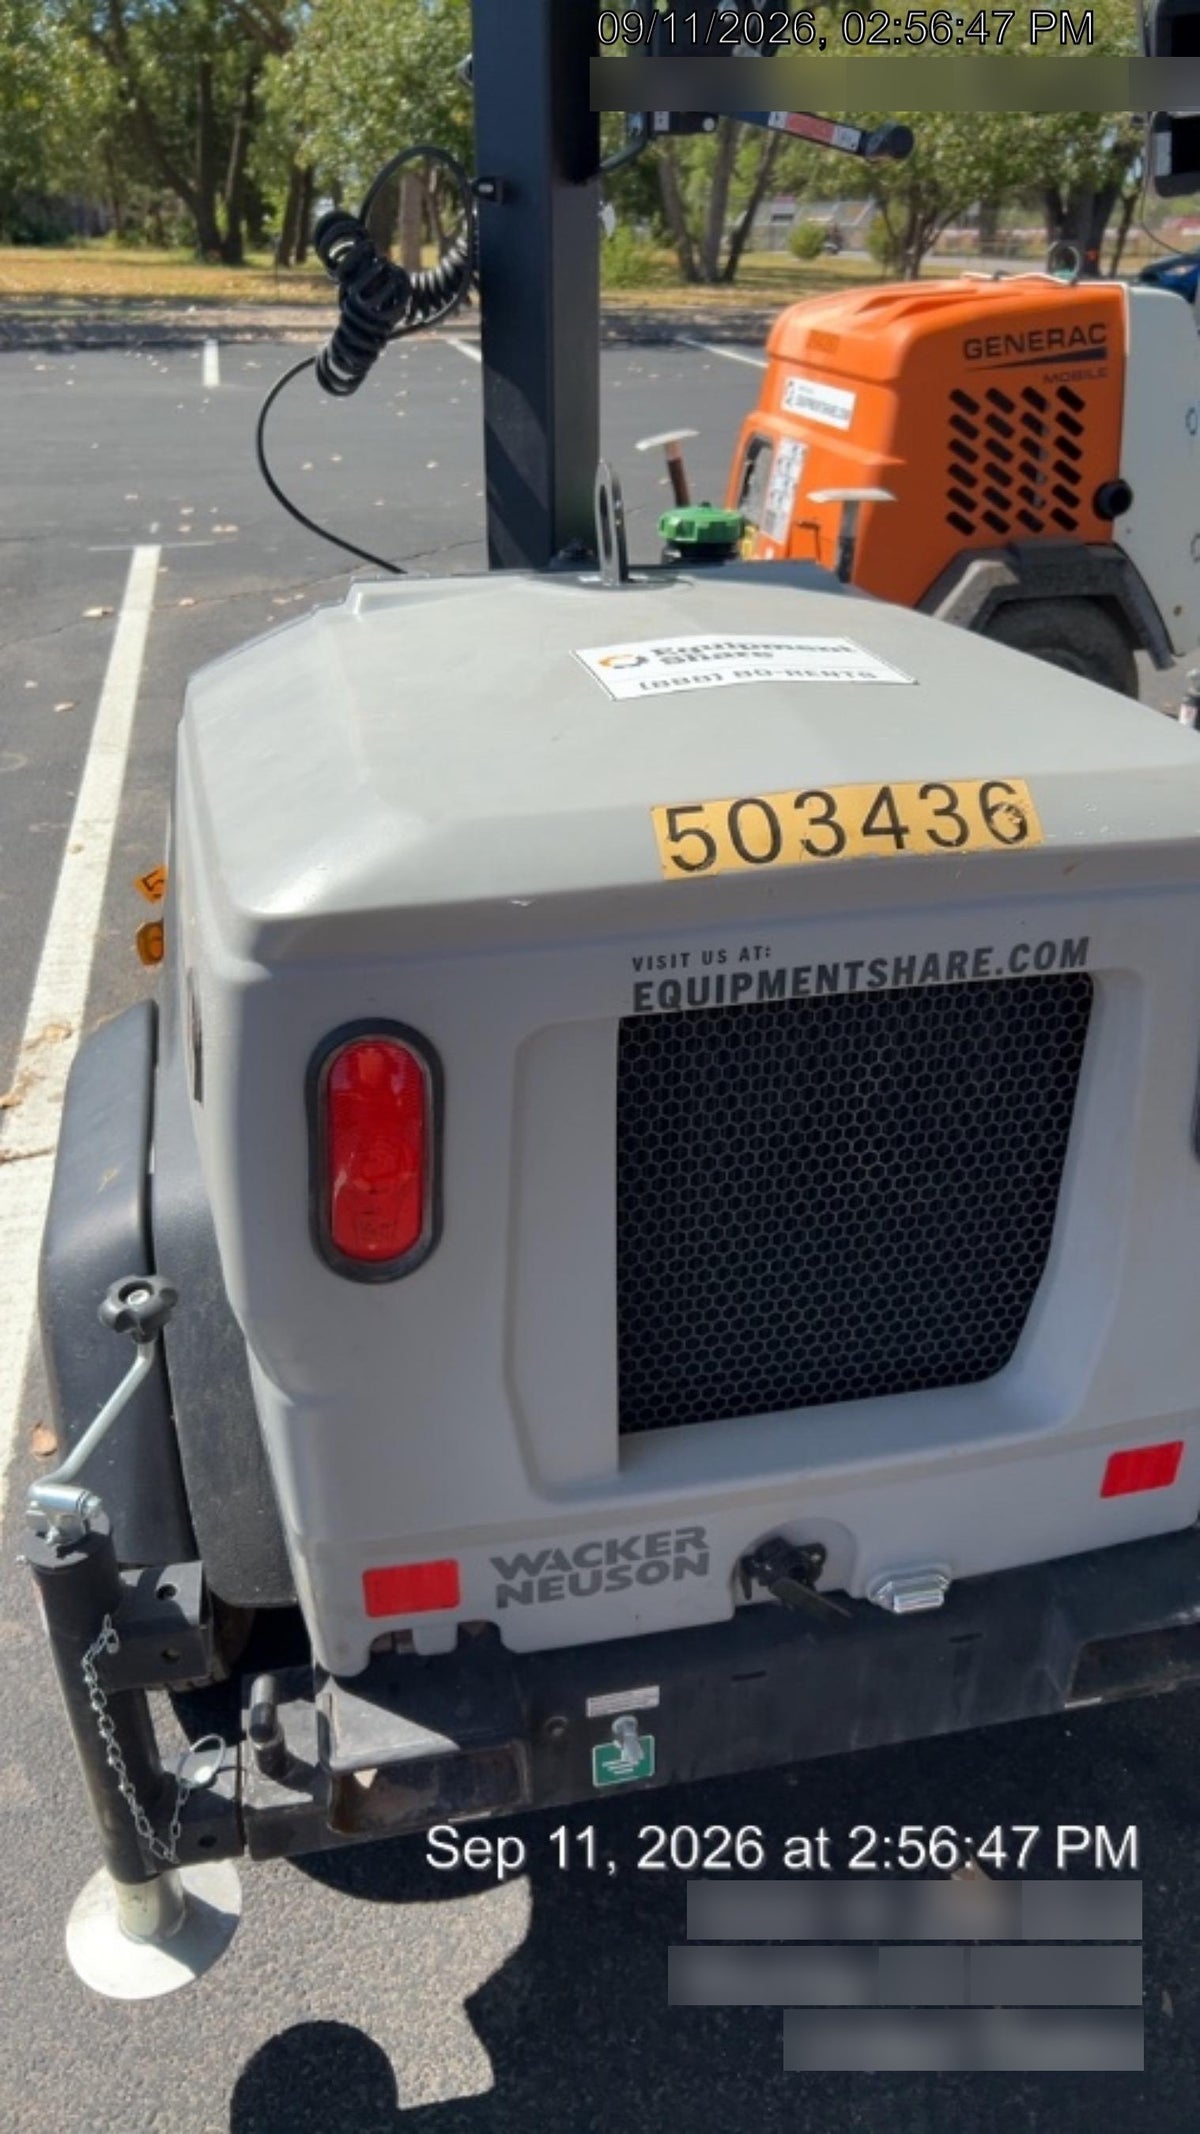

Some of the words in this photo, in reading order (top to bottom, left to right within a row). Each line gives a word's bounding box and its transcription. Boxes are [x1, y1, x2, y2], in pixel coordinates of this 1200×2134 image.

[964, 323, 1107, 360] GENERAC
[1044, 366, 1107, 384] MOBILE
[650, 641, 854, 656] Equipment
[665, 780, 1030, 873] 503436
[632, 952, 691, 972] VISIT
[702, 948, 728, 966] US
[739, 945, 771, 963] AT:
[633, 936, 1090, 1013] EQUIPMENTSHARE.COM
[490, 1526, 709, 1580] WACKER
[496, 1552, 710, 1608] NEUSON
